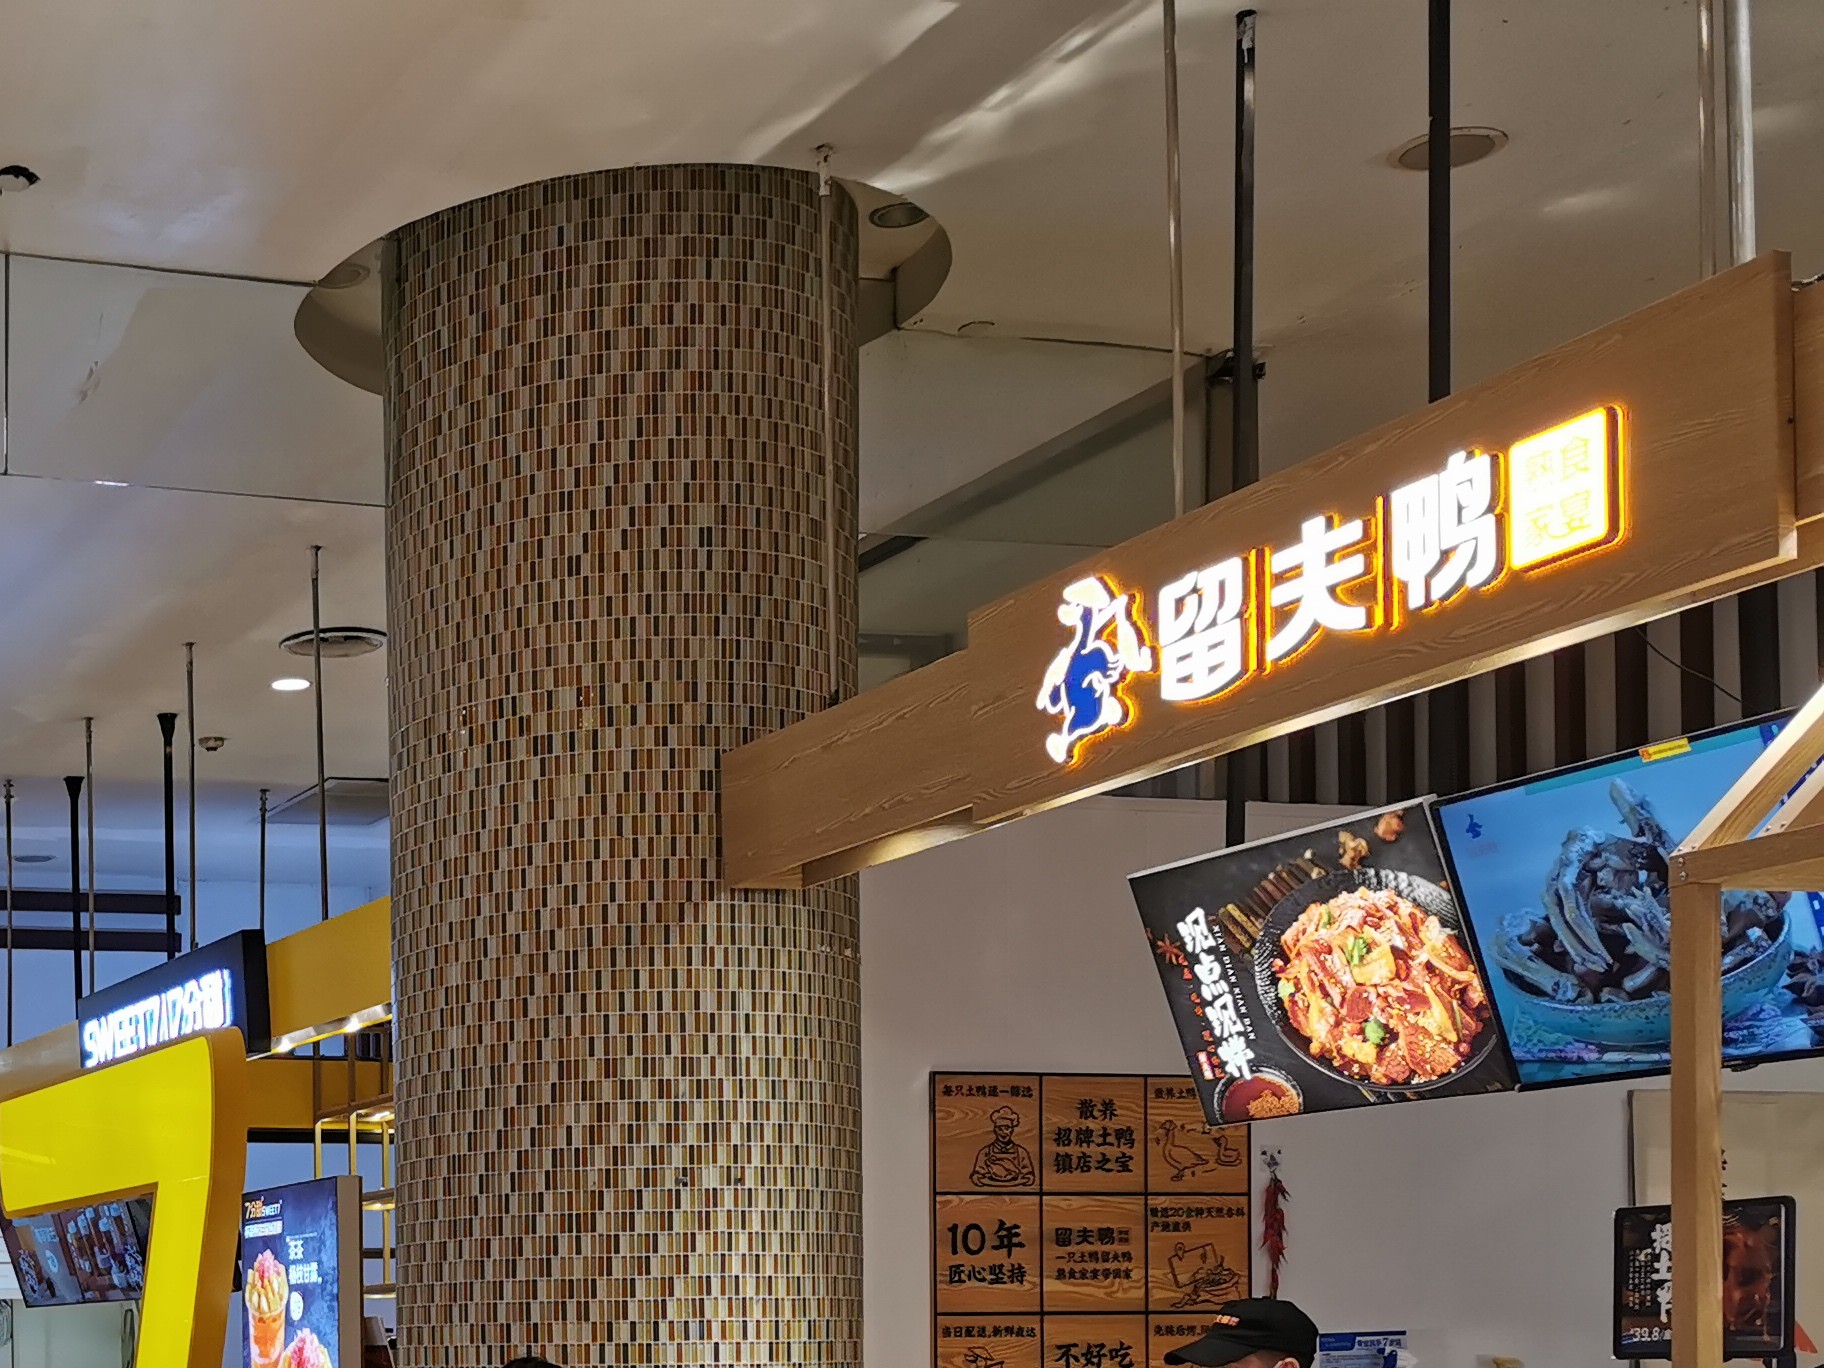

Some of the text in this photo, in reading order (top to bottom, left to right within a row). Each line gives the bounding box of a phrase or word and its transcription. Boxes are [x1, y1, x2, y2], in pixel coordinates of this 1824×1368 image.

[1158, 448, 1500, 704] 留夫鸭
[1177, 906, 1255, 1081] 现点现拌
[1211, 924, 1256, 1040] XIAN DIAN XIAN BAN
[1077, 1099, 1118, 1121] 散养
[1053, 1126, 1136, 1149] 招牌土鸭
[1053, 1152, 1134, 1174] 镇店之宝
[946, 1219, 1027, 1259] 10年
[1055, 1226, 1115, 1247] 留夫鸭
[948, 1264, 1027, 1285] 匠心坚持
[1054, 1341, 1135, 1368] 不好吃
